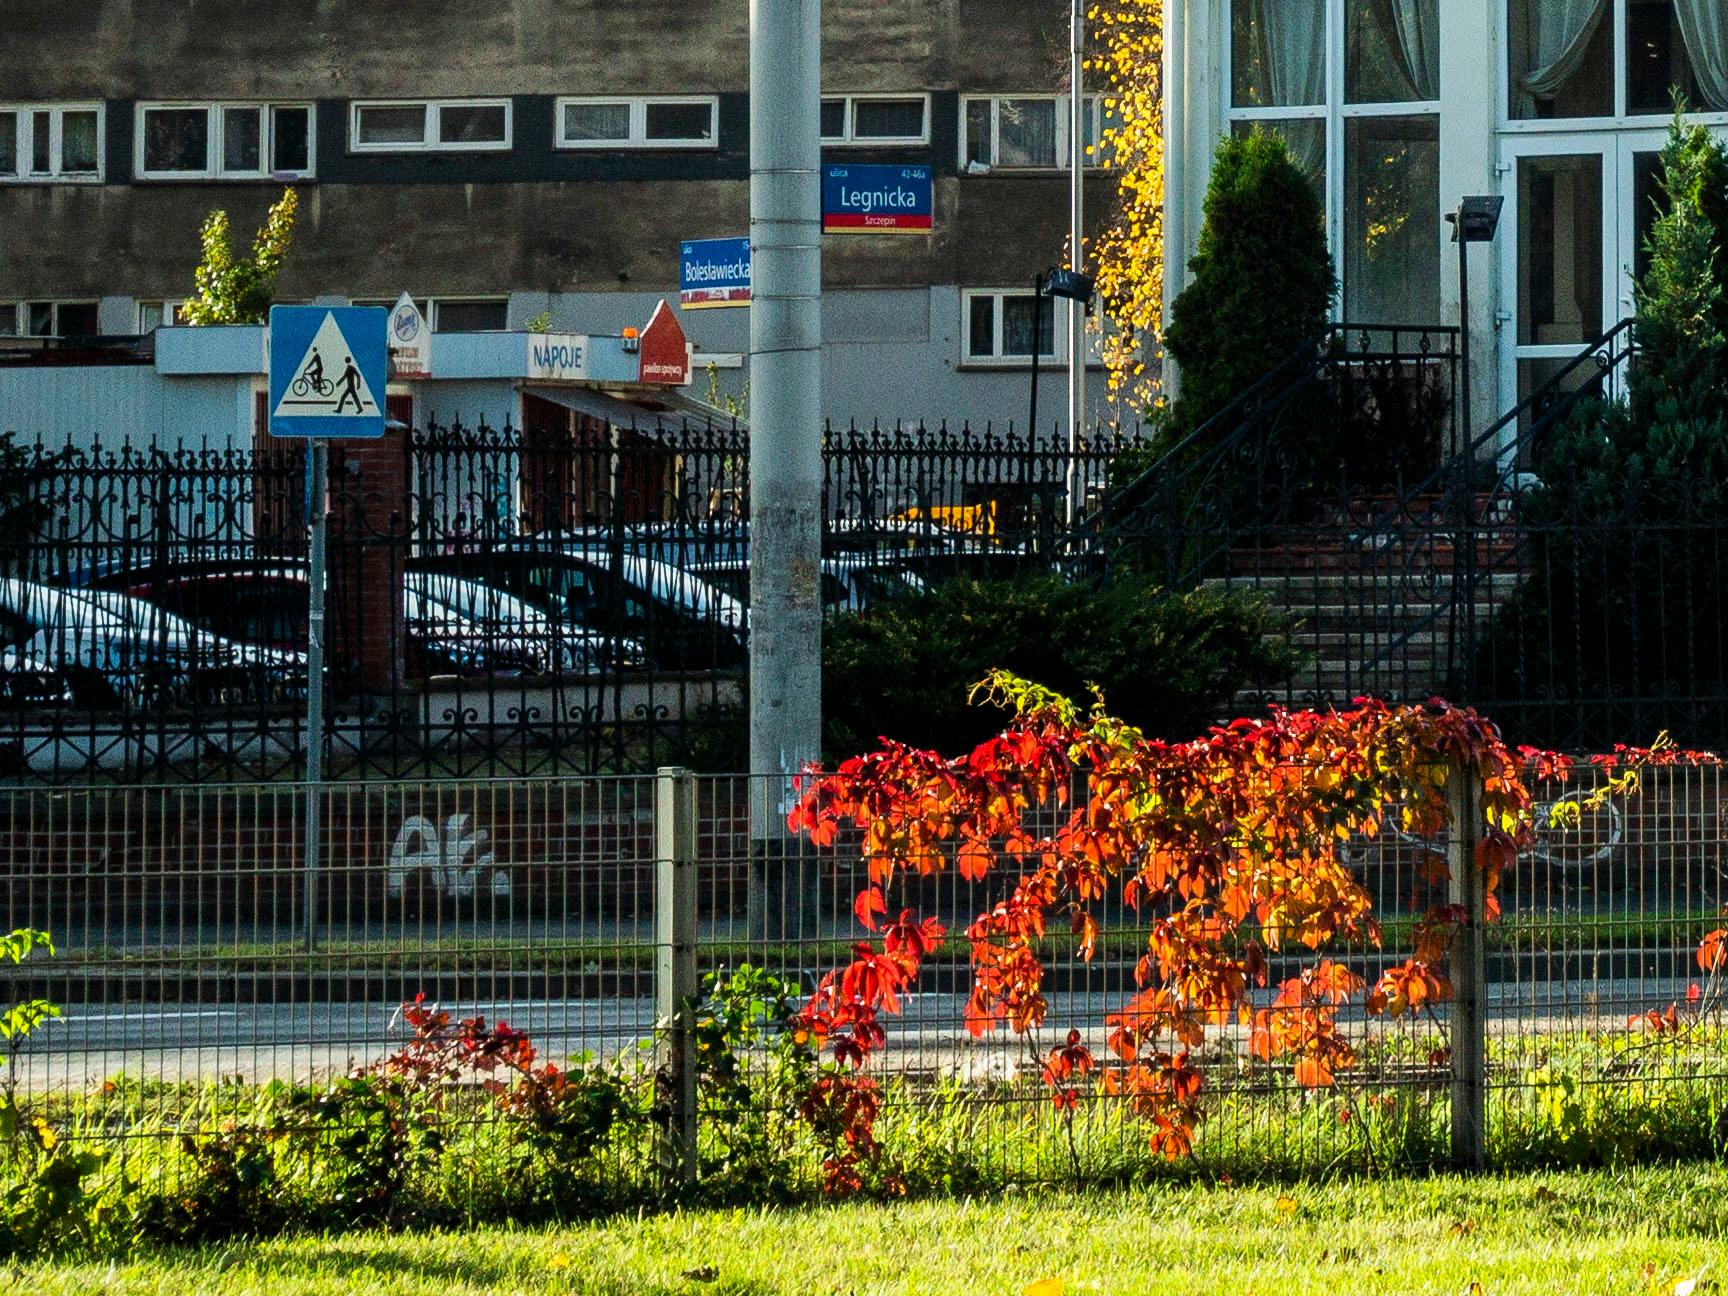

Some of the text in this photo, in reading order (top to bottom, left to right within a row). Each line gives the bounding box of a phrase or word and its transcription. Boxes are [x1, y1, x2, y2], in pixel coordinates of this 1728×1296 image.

[841, 185, 916, 212] Legnicka
[864, 215, 896, 227] Szczepin
[685, 256, 751, 282] Bolesławiecka
[533, 344, 583, 369] NAPOJE
